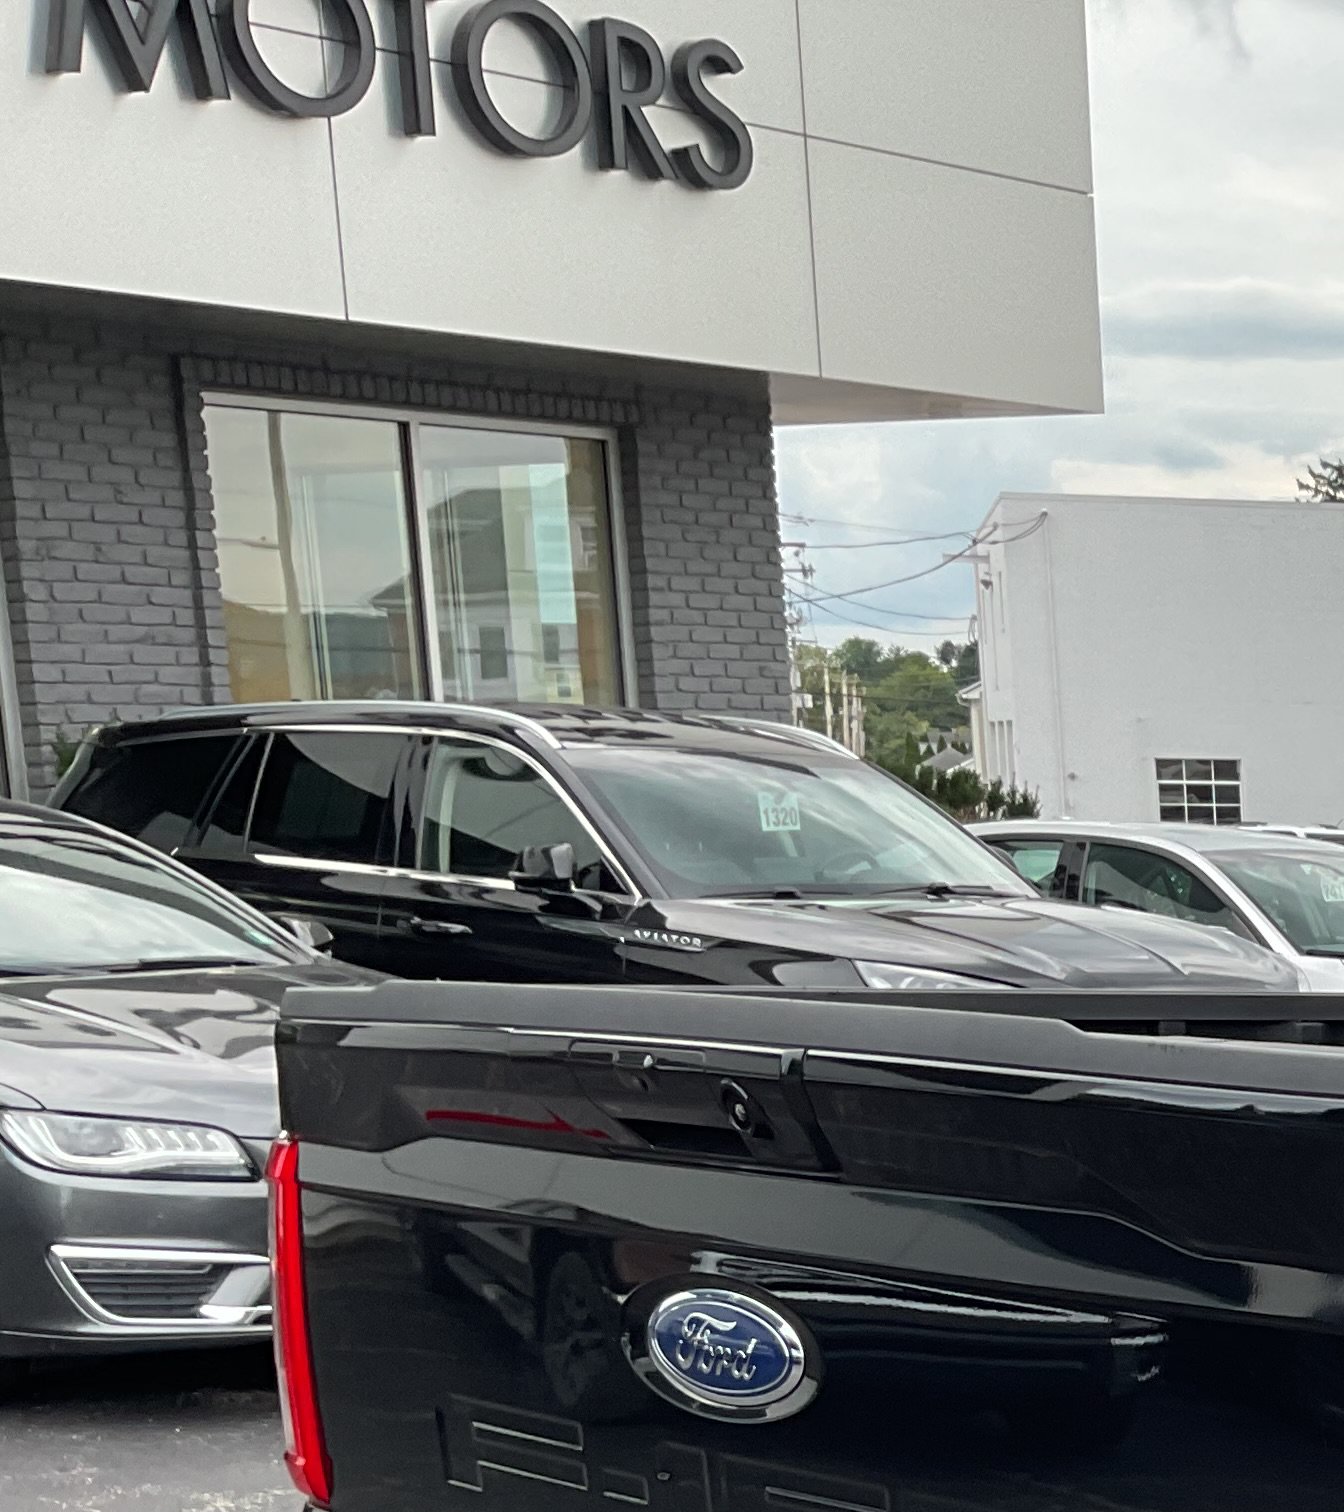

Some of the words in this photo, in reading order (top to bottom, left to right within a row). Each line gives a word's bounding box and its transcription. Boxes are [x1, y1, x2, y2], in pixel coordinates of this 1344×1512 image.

[763, 807, 798, 827] 1320
[633, 929, 702, 948] AVIATOR
[675, 1311, 758, 1382] Ford
